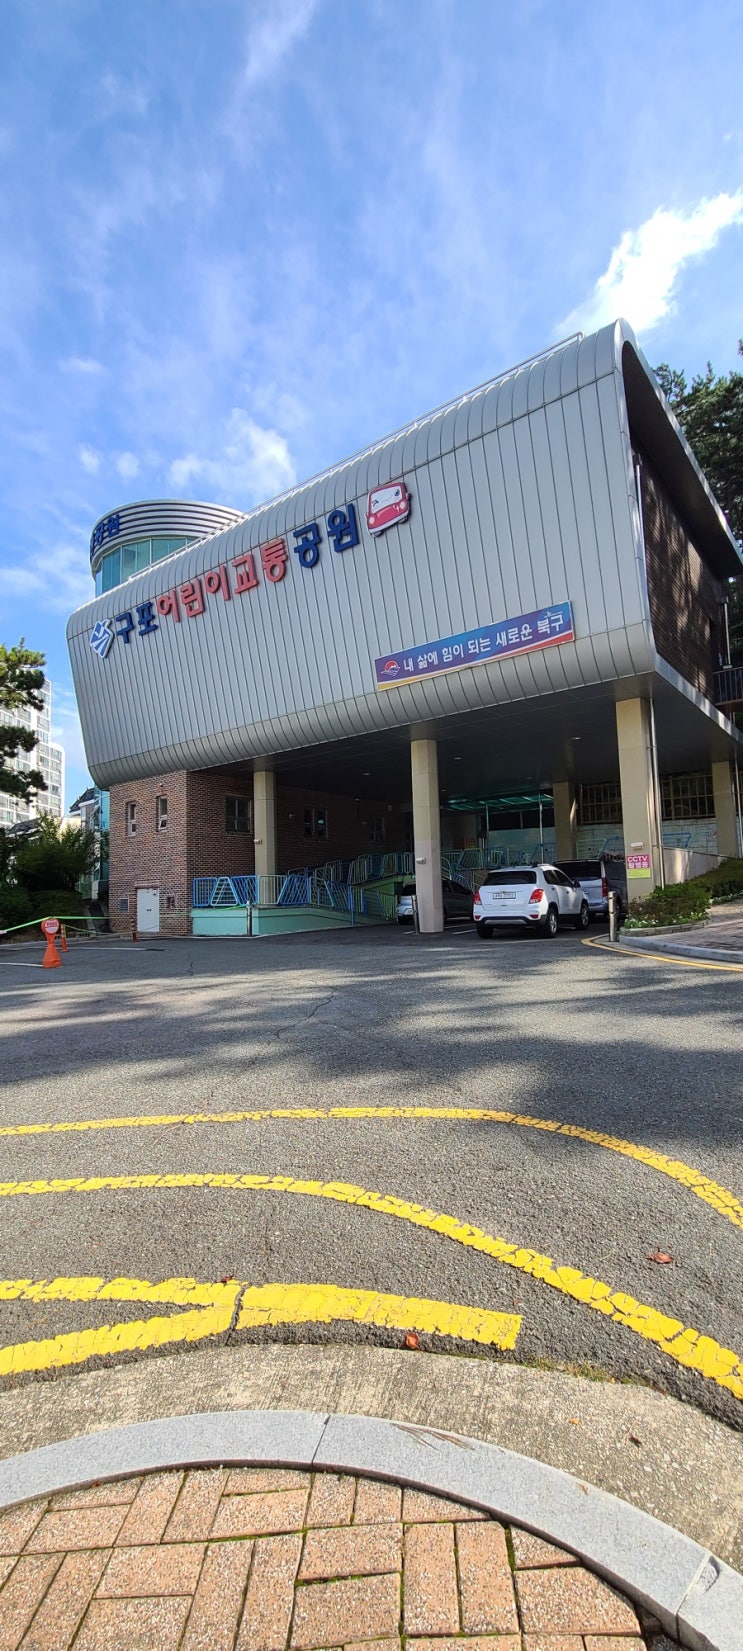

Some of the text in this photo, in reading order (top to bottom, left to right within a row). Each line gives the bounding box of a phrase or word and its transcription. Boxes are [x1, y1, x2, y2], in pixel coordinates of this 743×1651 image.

[403, 613, 564, 672] 내 삶에 힘이 되는 새로운 북구
